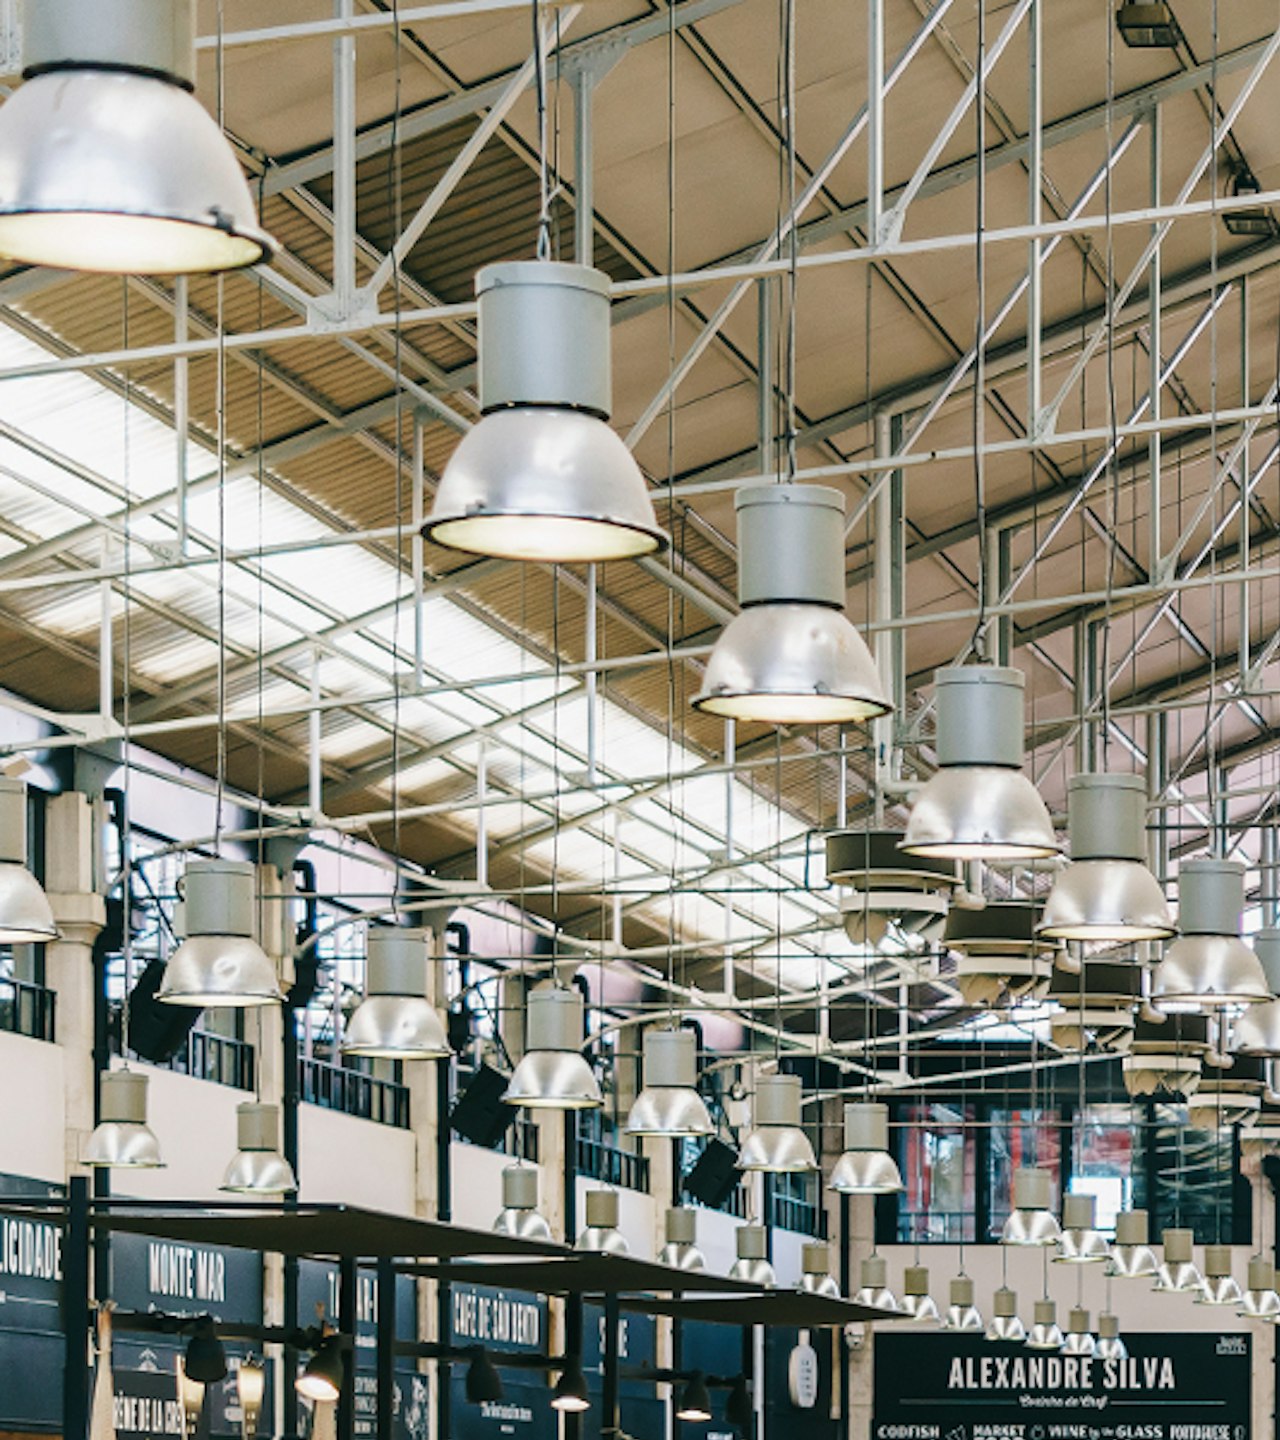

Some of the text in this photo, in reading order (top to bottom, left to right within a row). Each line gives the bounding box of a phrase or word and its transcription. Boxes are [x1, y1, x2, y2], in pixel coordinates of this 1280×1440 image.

[0, 1217, 64, 1281] ICIDADE
[149, 1242, 225, 1302] MONTE MAR
[948, 1357, 1176, 1389] ALEXANDRE SILVA
[877, 1424, 941, 1439] CODFISH
[973, 1424, 1026, 1437] MARKET
[1115, 1424, 1163, 1438] GLASS
